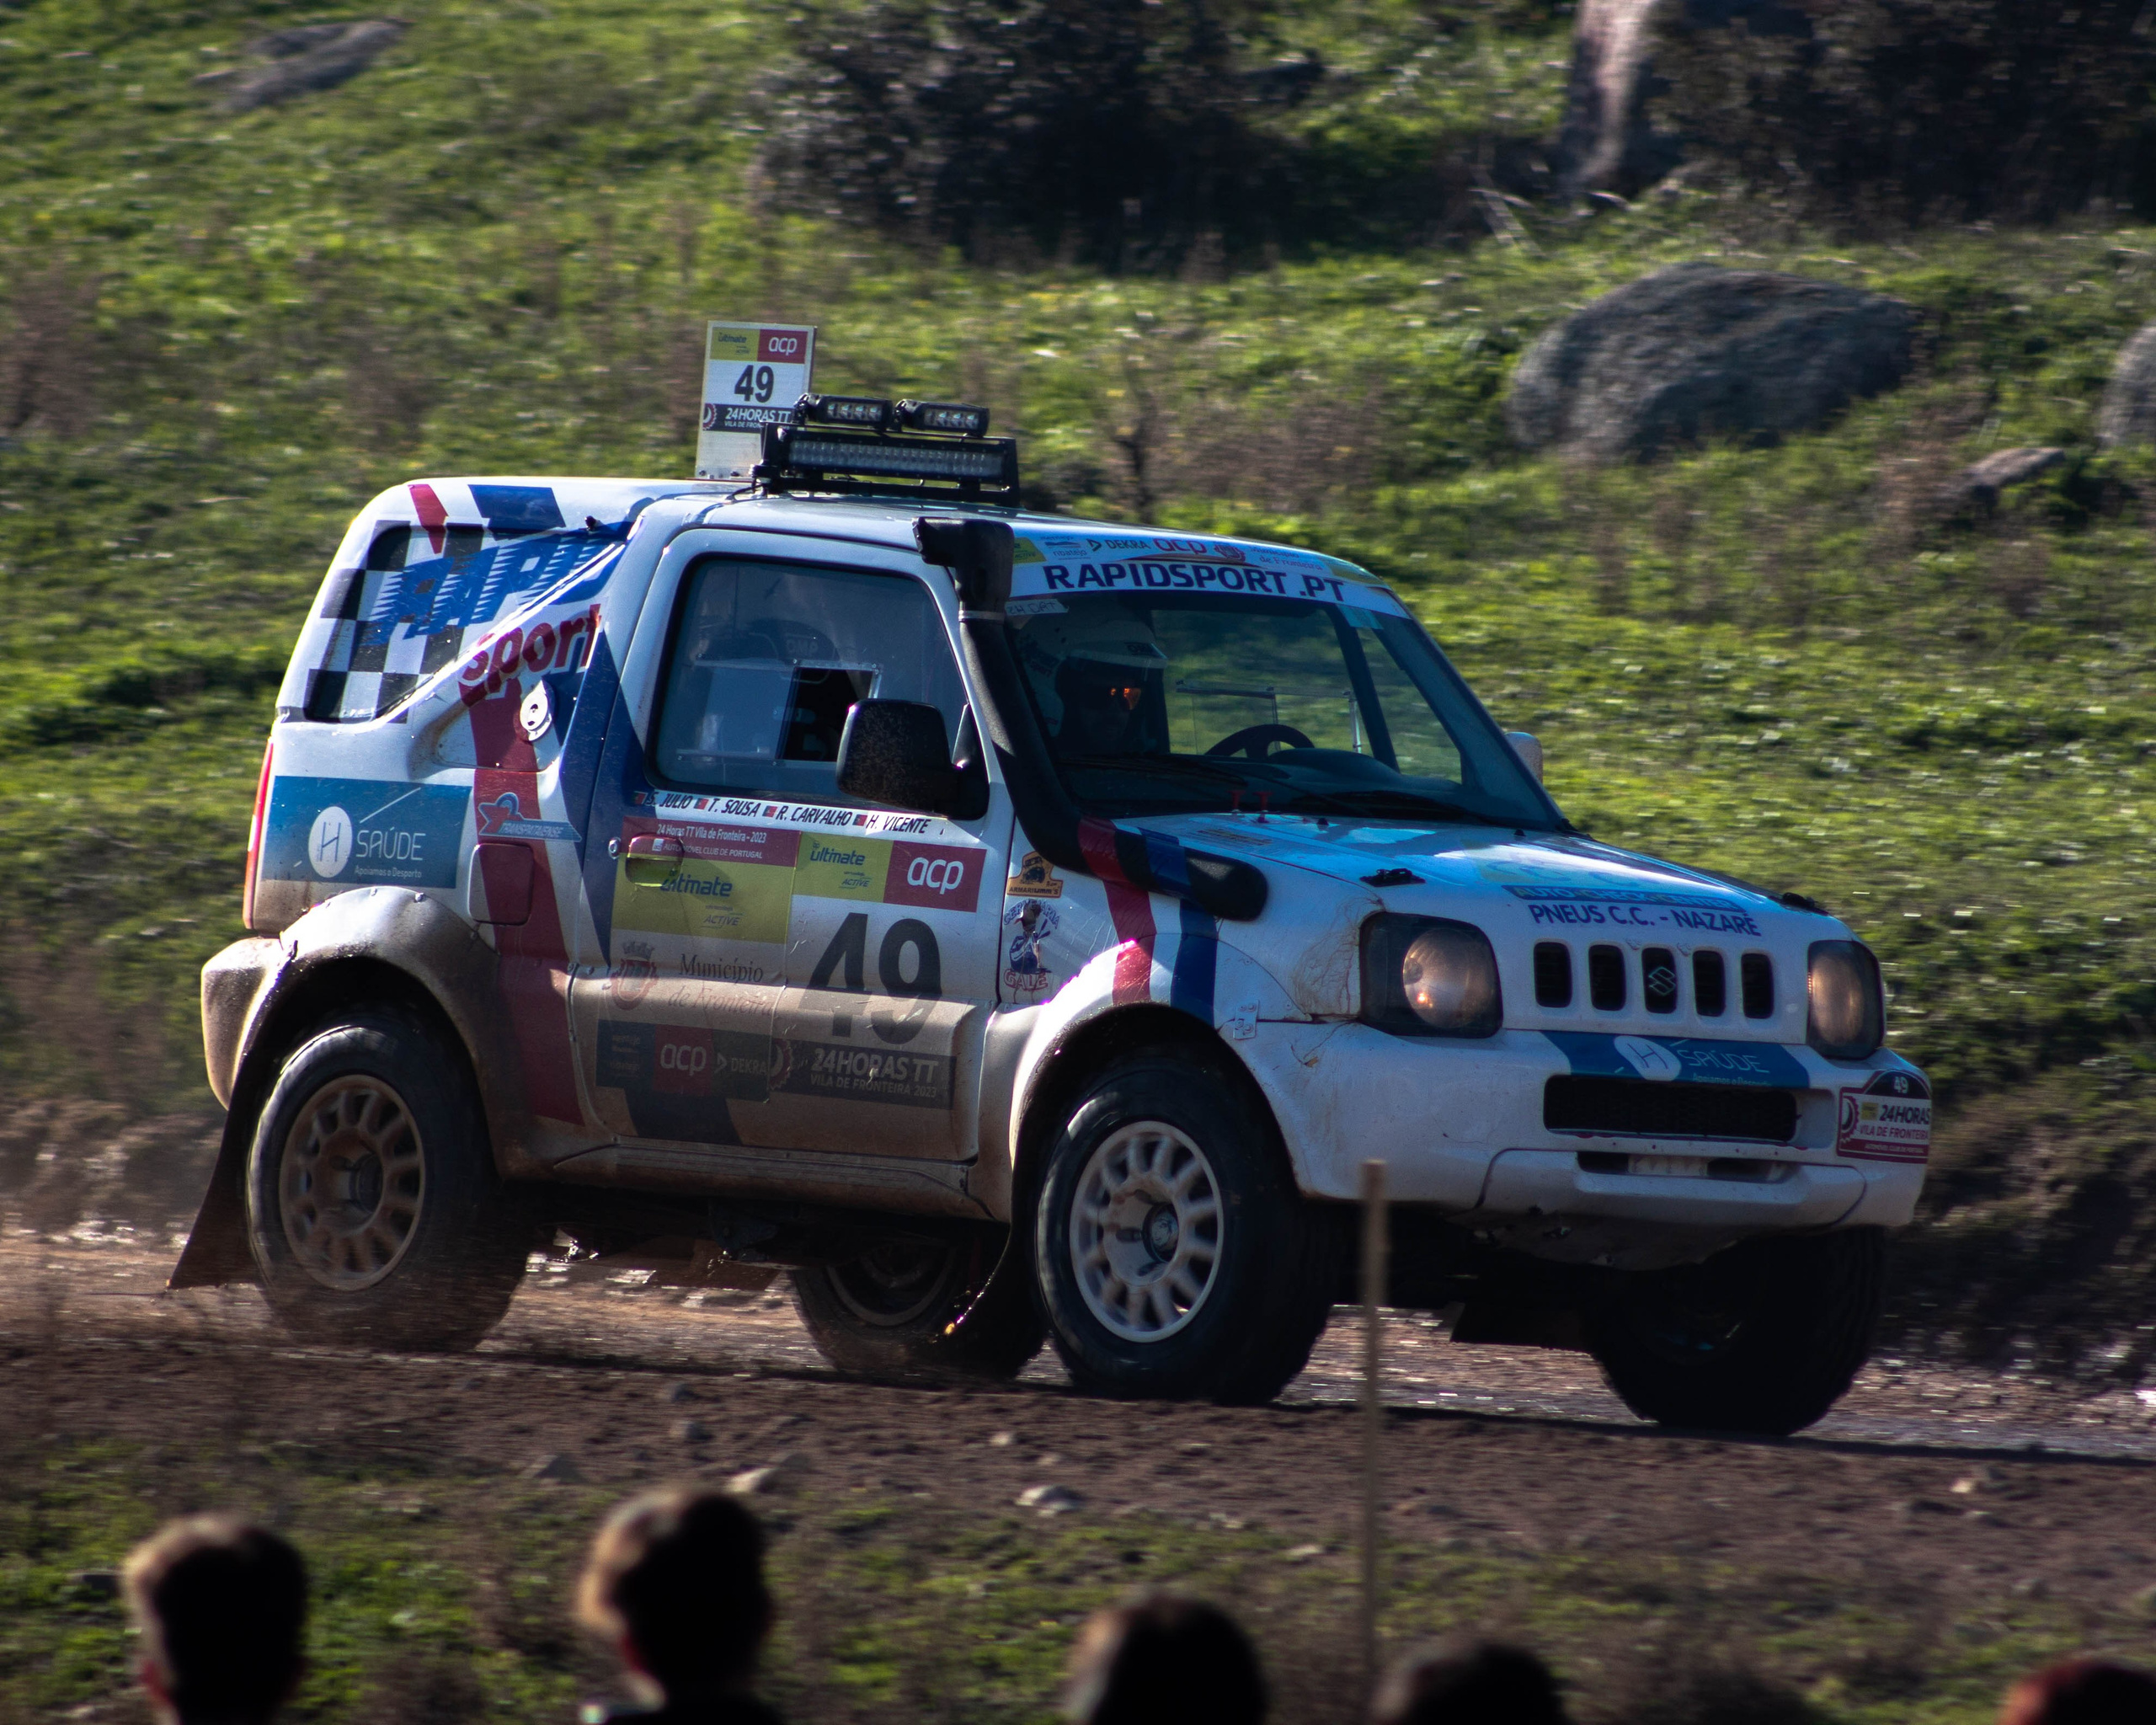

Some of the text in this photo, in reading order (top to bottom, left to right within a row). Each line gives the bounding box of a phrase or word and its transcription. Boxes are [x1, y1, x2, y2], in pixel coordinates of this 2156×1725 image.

[768, 337, 798, 356] acp
[734, 364, 774, 403] 49
[777, 410, 792, 423] TT
[1104, 539, 1150, 550] DEKRA
[1152, 537, 1207, 555] acp
[1260, 555, 1272, 563] de
[462, 603, 602, 693] sport
[708, 798, 718, 814] T.
[721, 799, 761, 818] SOUSA
[776, 805, 787, 821] R.
[790, 807, 853, 826] CARVALHO
[866, 814, 878, 830] H.
[883, 815, 931, 834] VICENTE
[355, 826, 426, 861] SAÚDE
[656, 824, 665, 835] 24
[666, 825, 685, 836] Horas
[686, 826, 695, 836] TT
[695, 827, 707, 838] Vila
[707, 828, 716, 839] de
[717, 829, 746, 841] Fronteira
[750, 831, 767, 843] 2023
[702, 847, 719, 856] CLUB
[728, 850, 763, 859] PORTUGAL
[354, 865, 387, 877] Apoiamos
[392, 867, 422, 879] Desporto
[841, 879, 870, 888] ACTIVE
[907, 857, 963, 895] acp
[659, 873, 733, 898] utimate
[704, 915, 740, 927] ACTIVE
[1528, 904, 1606, 925] PNEUS
[1608, 905, 1656, 926] C.C.
[1670, 910, 1763, 937] NAZARÉ
[679, 953, 765, 983] Município
[798, 912, 943, 1044] 49
[668, 985, 778, 1017] de Fronteira
[659, 1043, 707, 1076] acp
[731, 1057, 769, 1076] DEKRA
[810, 1048, 939, 1083] 24HORAS TT
[1677, 1049, 1770, 1074] SAÚDE
[810, 1074, 937, 1098] VILA DE FRONTEIRA 2023
[1893, 1076, 1909, 1094] 49
[1859, 1124, 1875, 1136] VILA
[1876, 1126, 1887, 1137] DE
